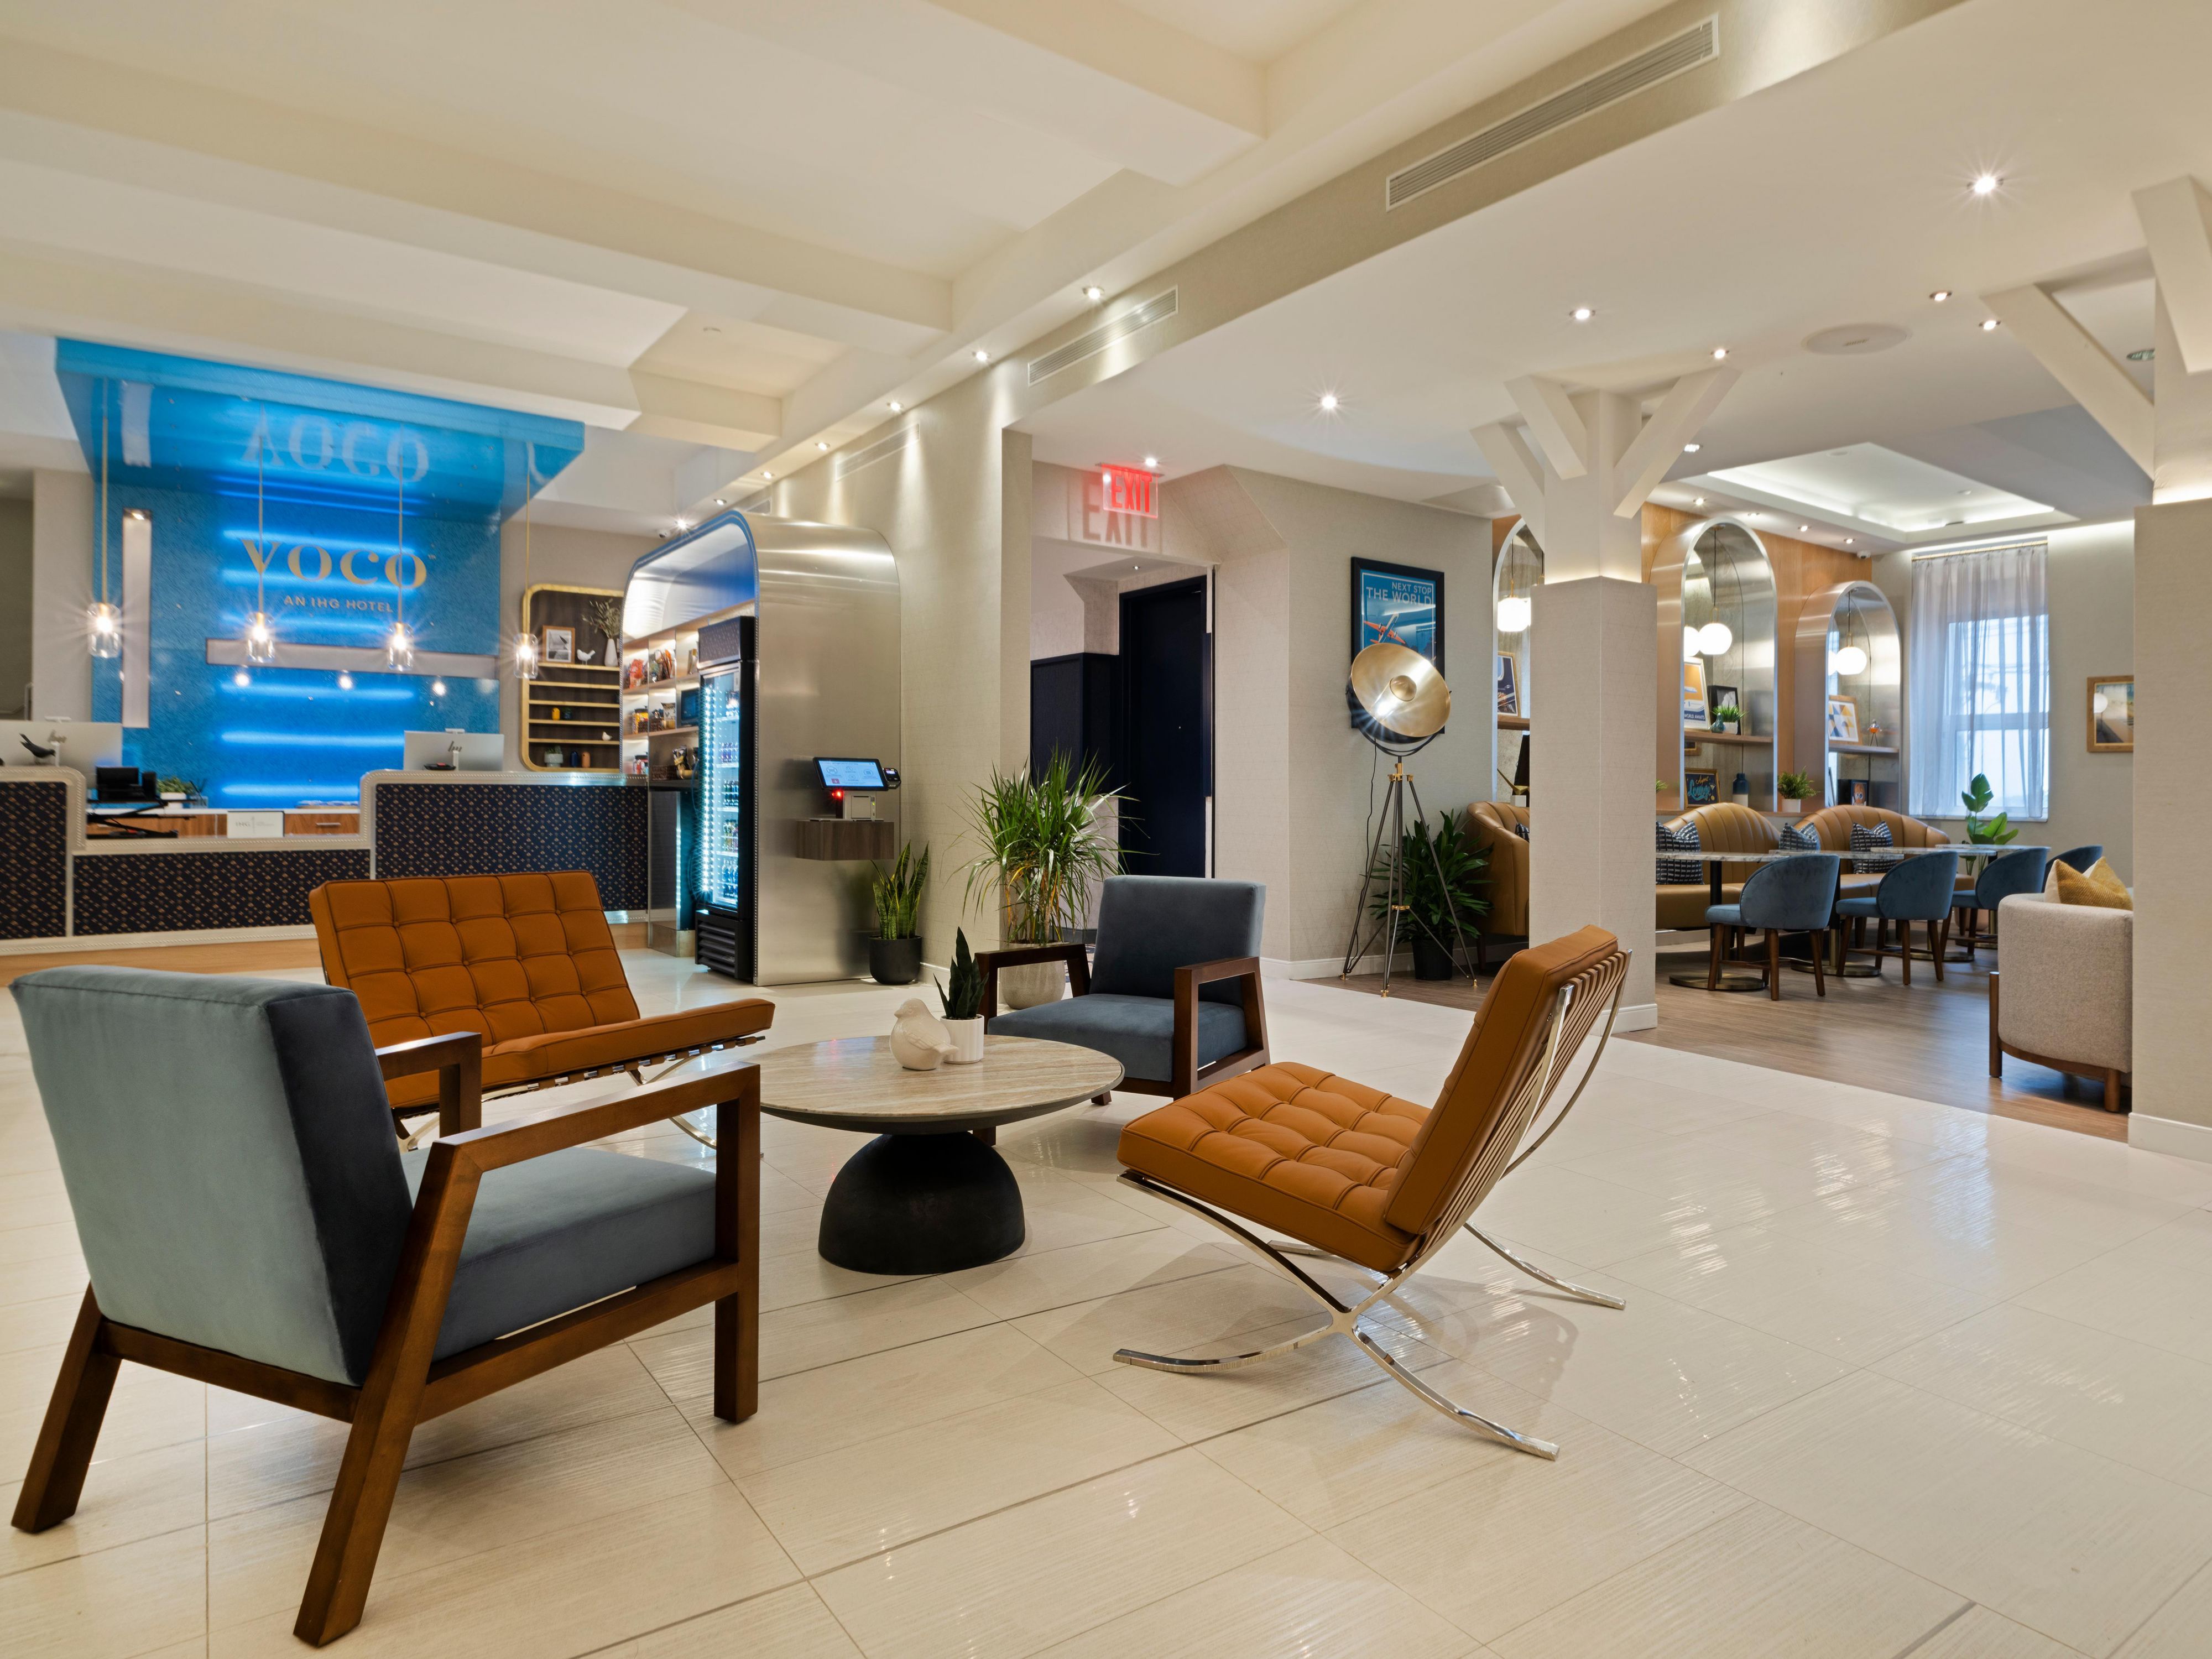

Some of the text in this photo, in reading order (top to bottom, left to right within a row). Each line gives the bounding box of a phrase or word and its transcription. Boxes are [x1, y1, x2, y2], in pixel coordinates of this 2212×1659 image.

[1110, 469, 1152, 513] EXIT
[1366, 587, 1432, 607] THE WORLD
[1392, 582, 1432, 595] NEXT STOP
[284, 595, 394, 613] AN IHG HOTEL
